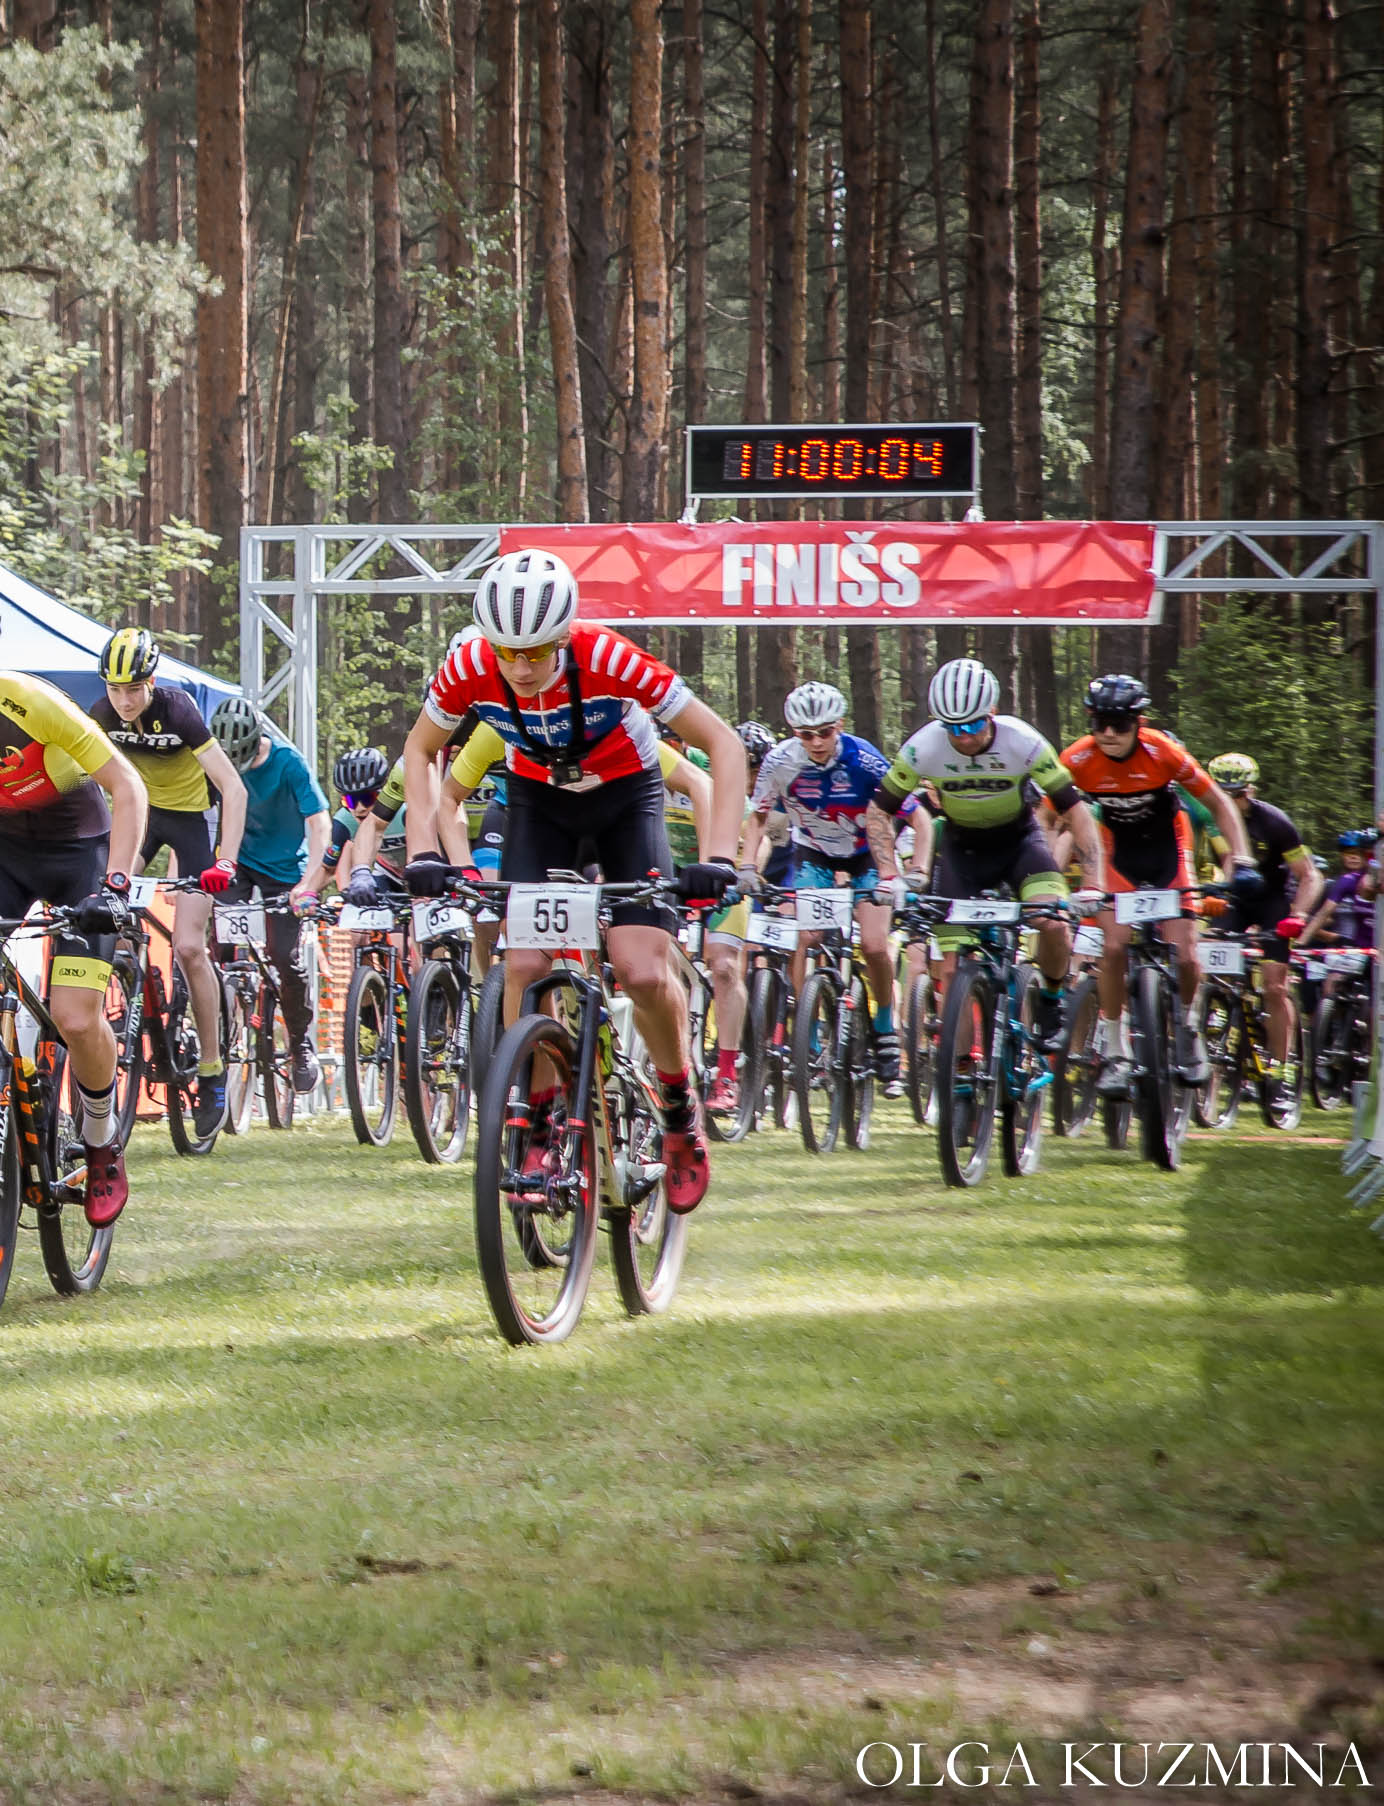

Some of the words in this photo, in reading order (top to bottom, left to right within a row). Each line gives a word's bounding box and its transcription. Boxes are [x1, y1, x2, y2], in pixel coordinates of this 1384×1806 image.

[741, 438, 944, 479] 11:00:04
[722, 531, 921, 608] FINIŠS
[534, 898, 568, 933] 55
[1135, 896, 1159, 914] 27
